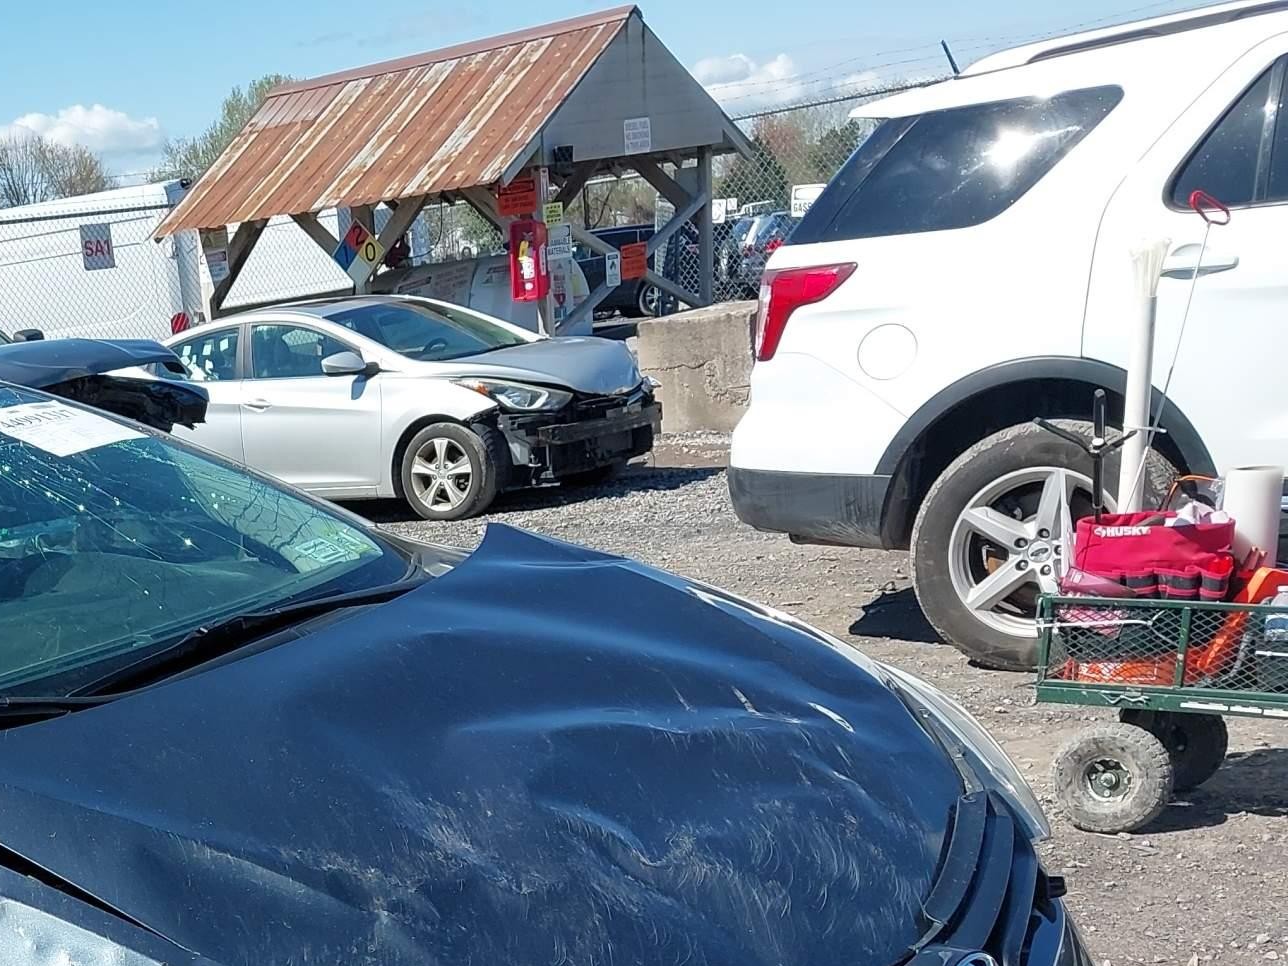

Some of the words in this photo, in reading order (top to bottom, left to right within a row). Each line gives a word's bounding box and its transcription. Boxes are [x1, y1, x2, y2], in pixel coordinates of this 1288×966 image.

[352, 225, 366, 247] 2
[84, 239, 111, 257] SA1
[364, 241, 377, 263] 0
[1106, 525, 1151, 538] HUSKY
